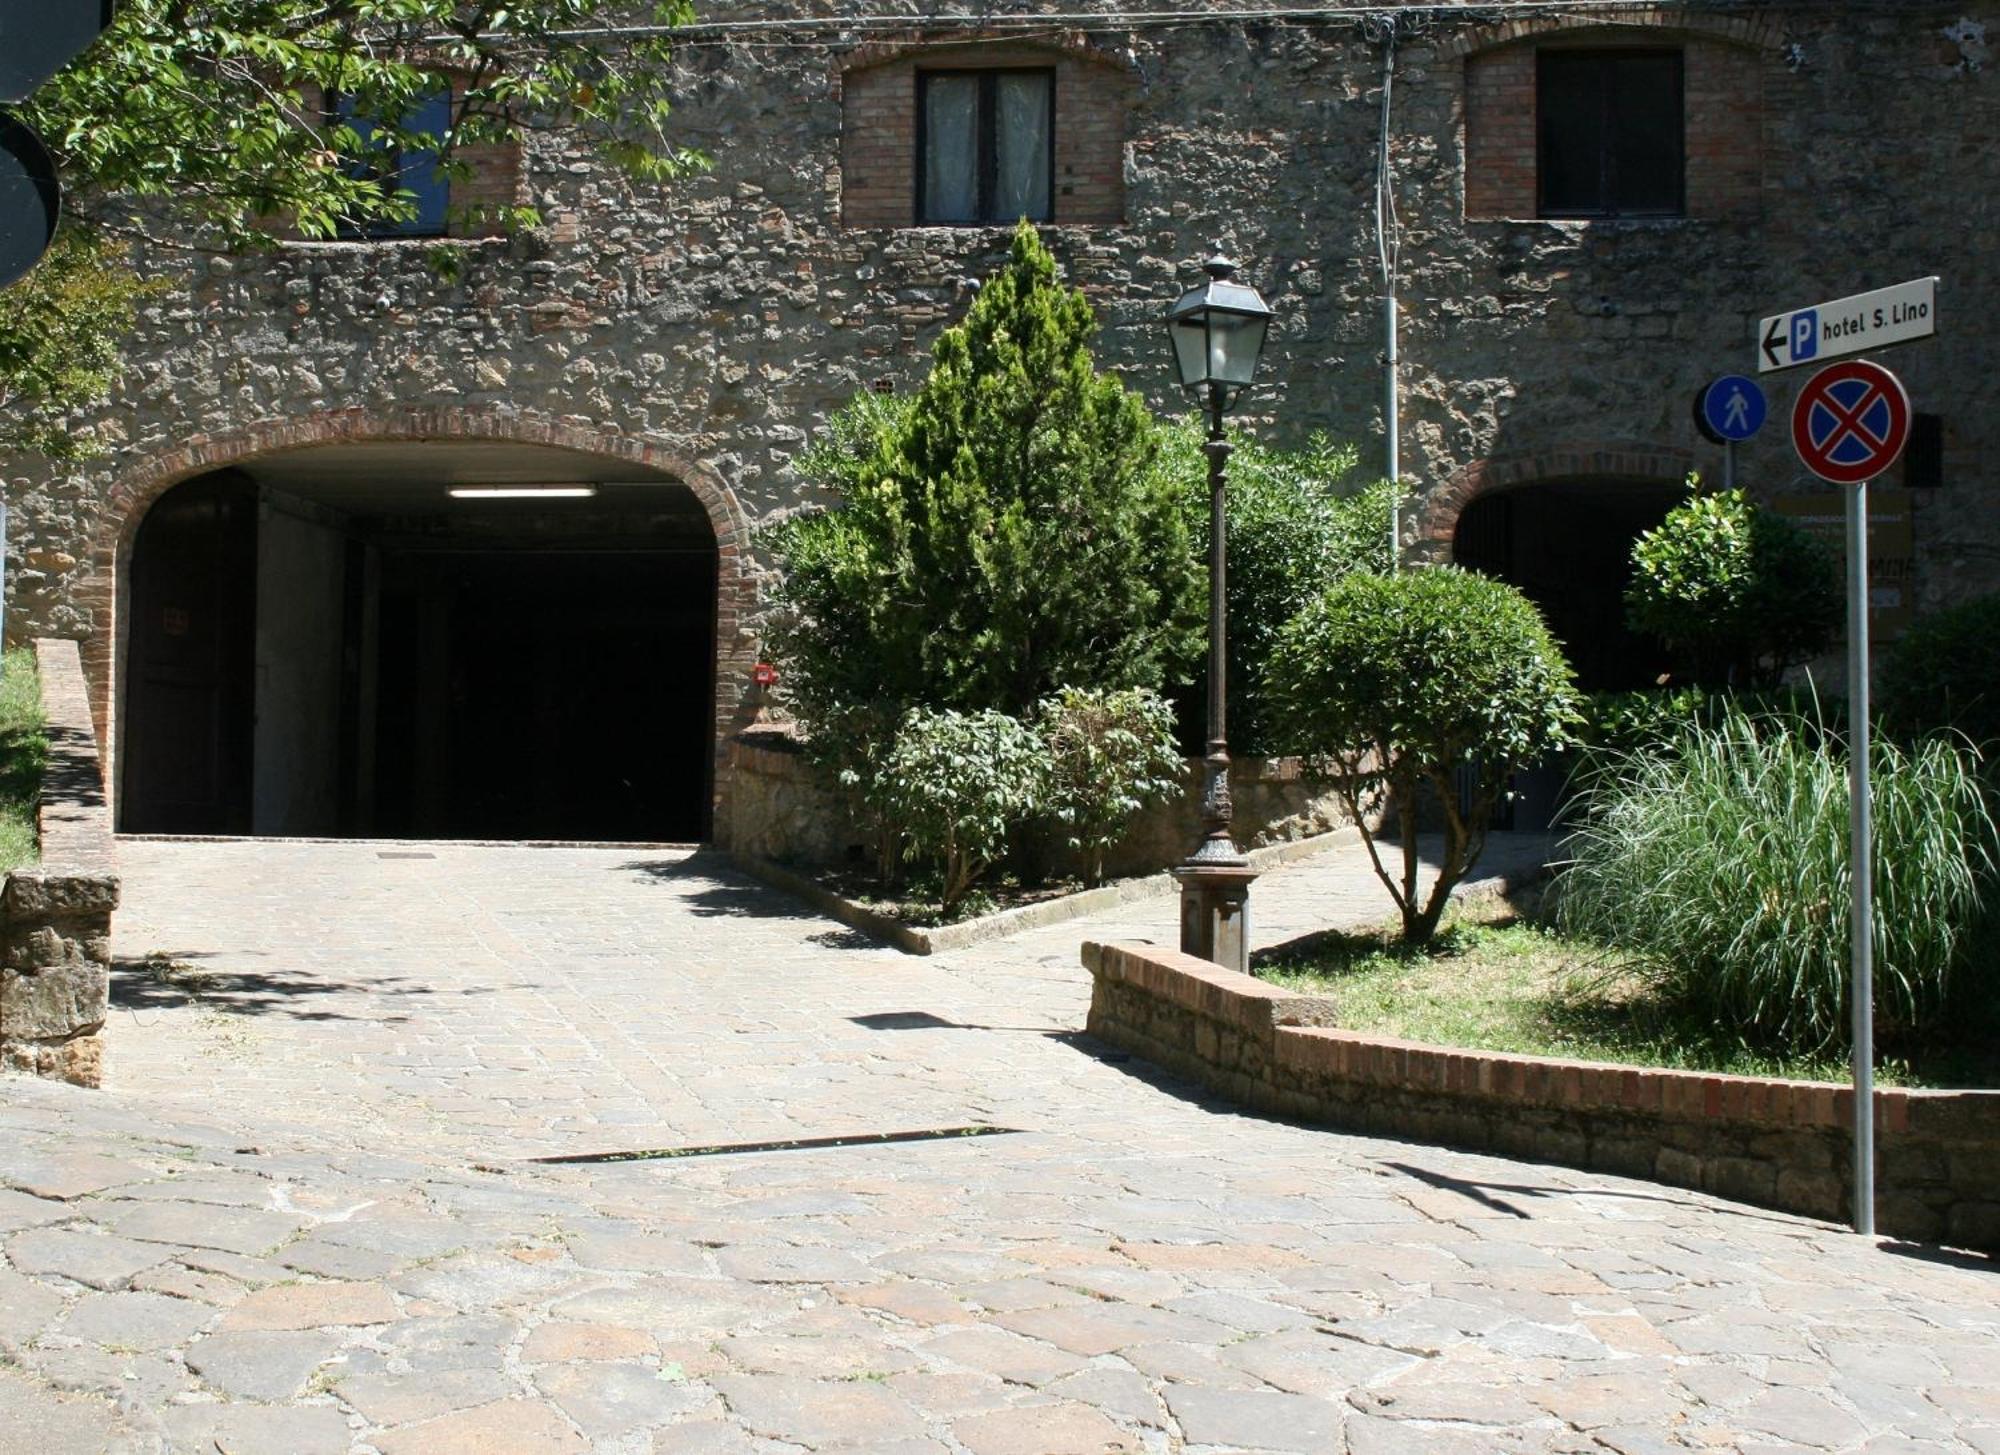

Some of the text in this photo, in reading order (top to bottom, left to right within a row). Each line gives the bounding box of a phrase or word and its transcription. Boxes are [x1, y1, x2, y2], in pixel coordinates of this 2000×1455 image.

[1796, 302, 1928, 355] P hotel S. Lino
